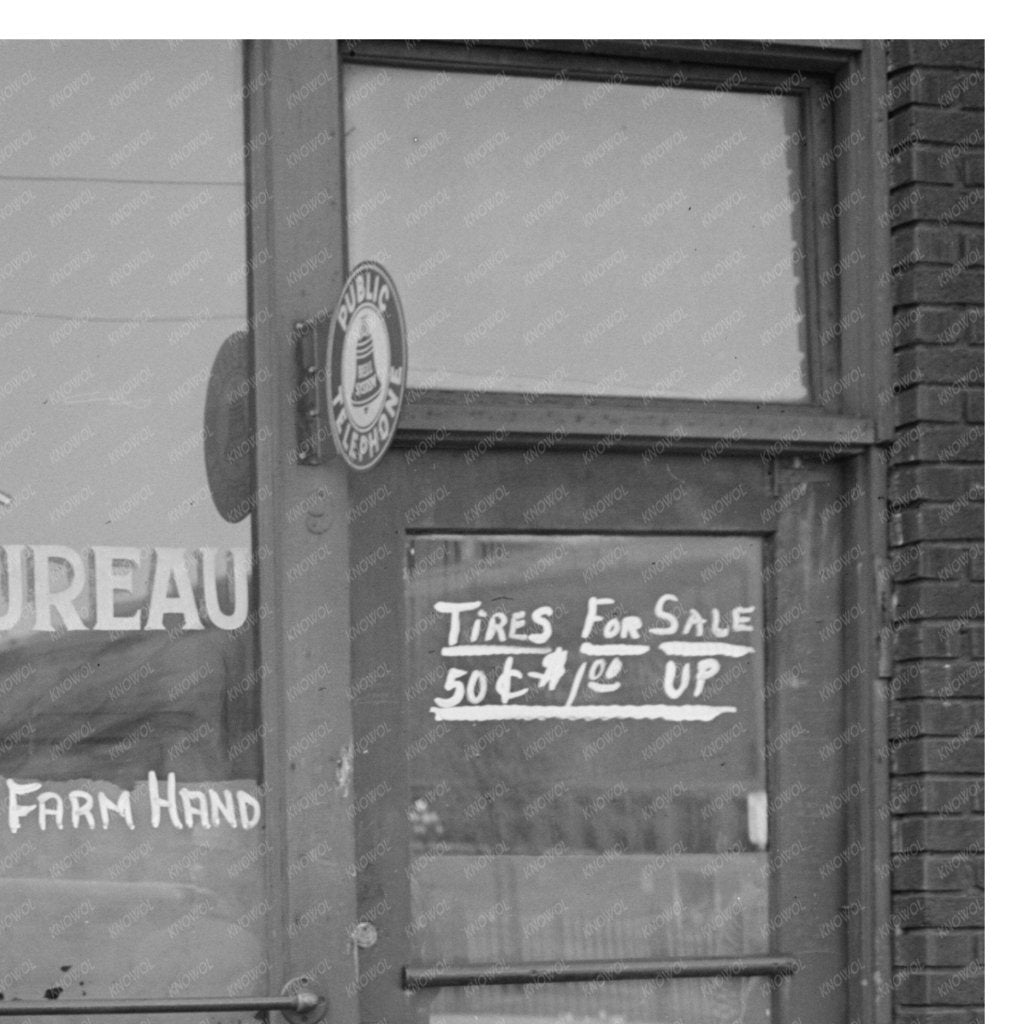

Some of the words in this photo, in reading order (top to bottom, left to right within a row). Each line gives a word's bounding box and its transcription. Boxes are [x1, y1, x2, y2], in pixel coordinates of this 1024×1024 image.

[338, 272, 390, 332] PUBLIC
[332, 366, 403, 463] TELEPHONE
[648, 593, 756, 638] SALE
[663, 657, 721, 700] UP
[5, 777, 137, 833] FARM
[146, 770, 262, 831] HAND
